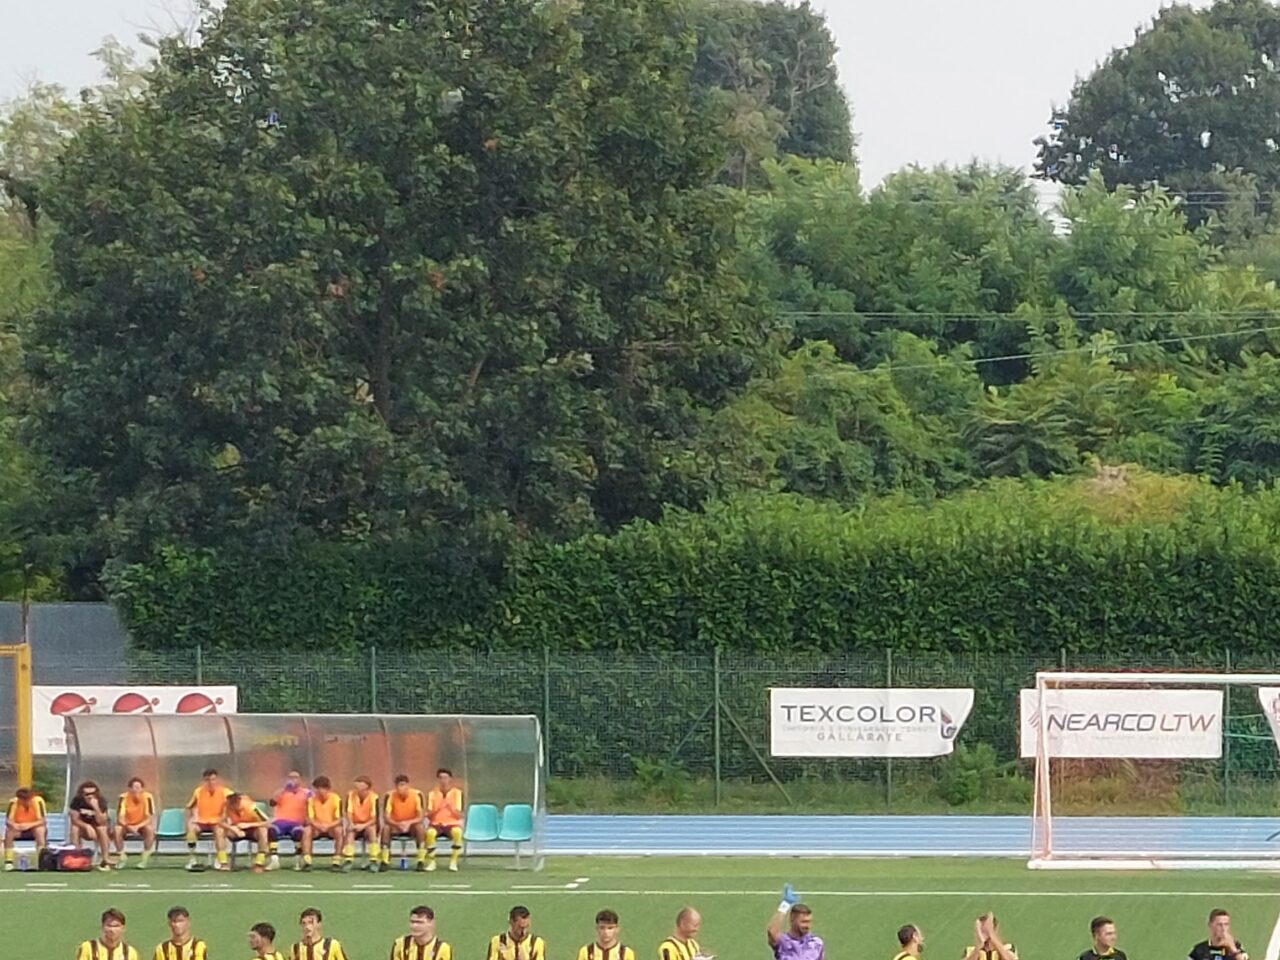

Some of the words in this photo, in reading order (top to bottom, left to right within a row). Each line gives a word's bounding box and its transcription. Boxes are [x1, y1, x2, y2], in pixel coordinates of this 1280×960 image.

[780, 705, 936, 722] TEXCOLOR
[1047, 714, 1157, 731] NEARCO
[1160, 714, 1216, 731] LTW
[817, 732, 904, 742] GALLARATE
